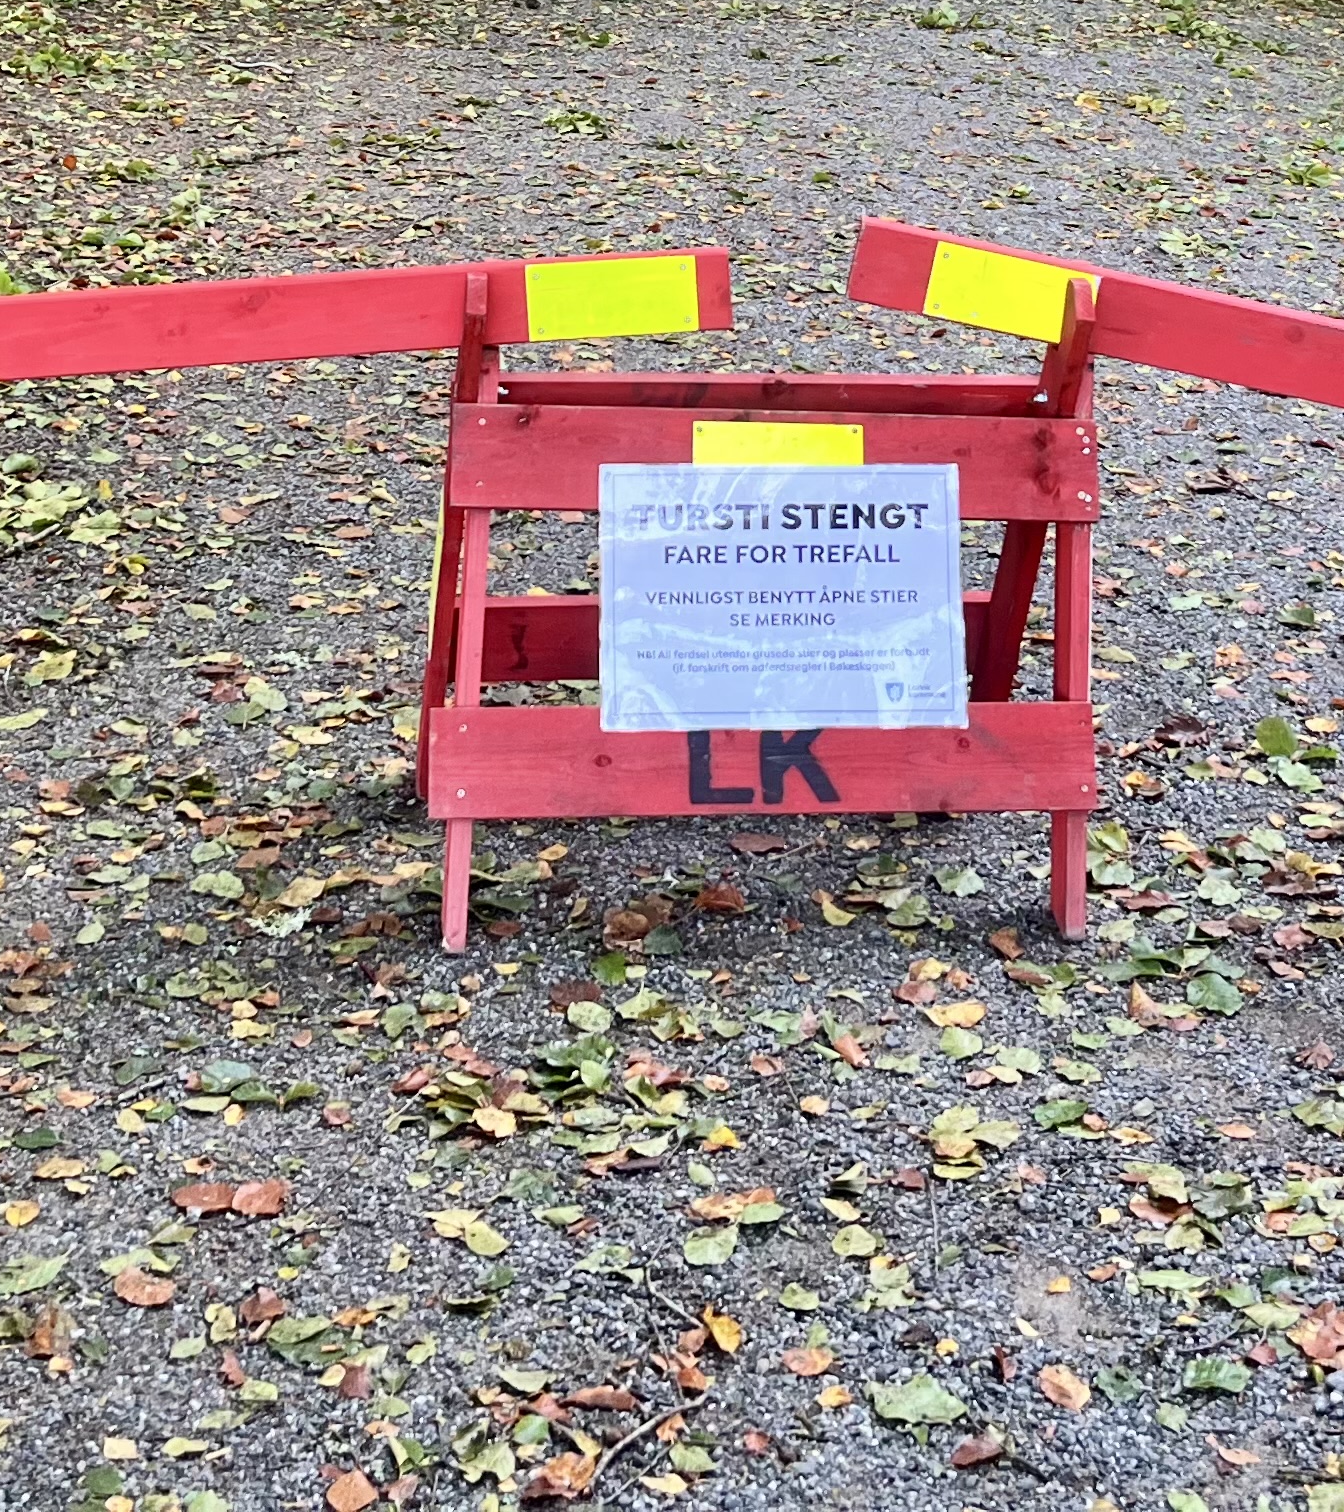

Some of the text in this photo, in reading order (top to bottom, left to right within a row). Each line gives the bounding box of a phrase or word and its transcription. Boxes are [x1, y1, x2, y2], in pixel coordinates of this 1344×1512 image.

[631, 502, 929, 530] TURSTI STENGT
[663, 544, 901, 564] FARE FOR TREFALL
[645, 585, 919, 605] VENNLIGST BENYTT ÅPNE STIER
[729, 612, 836, 627] SE MERKING
[636, 650, 656, 660] NB!
[658, 650, 671, 659] All
[674, 649, 710, 659] ferdsel
[797, 648, 820, 658] stier
[822, 649, 836, 659] og
[838, 648, 874, 659] plasser
[688, 662, 730, 673] forskrift
[732, 664, 749, 673] om
[687, 729, 841, 804] LK
